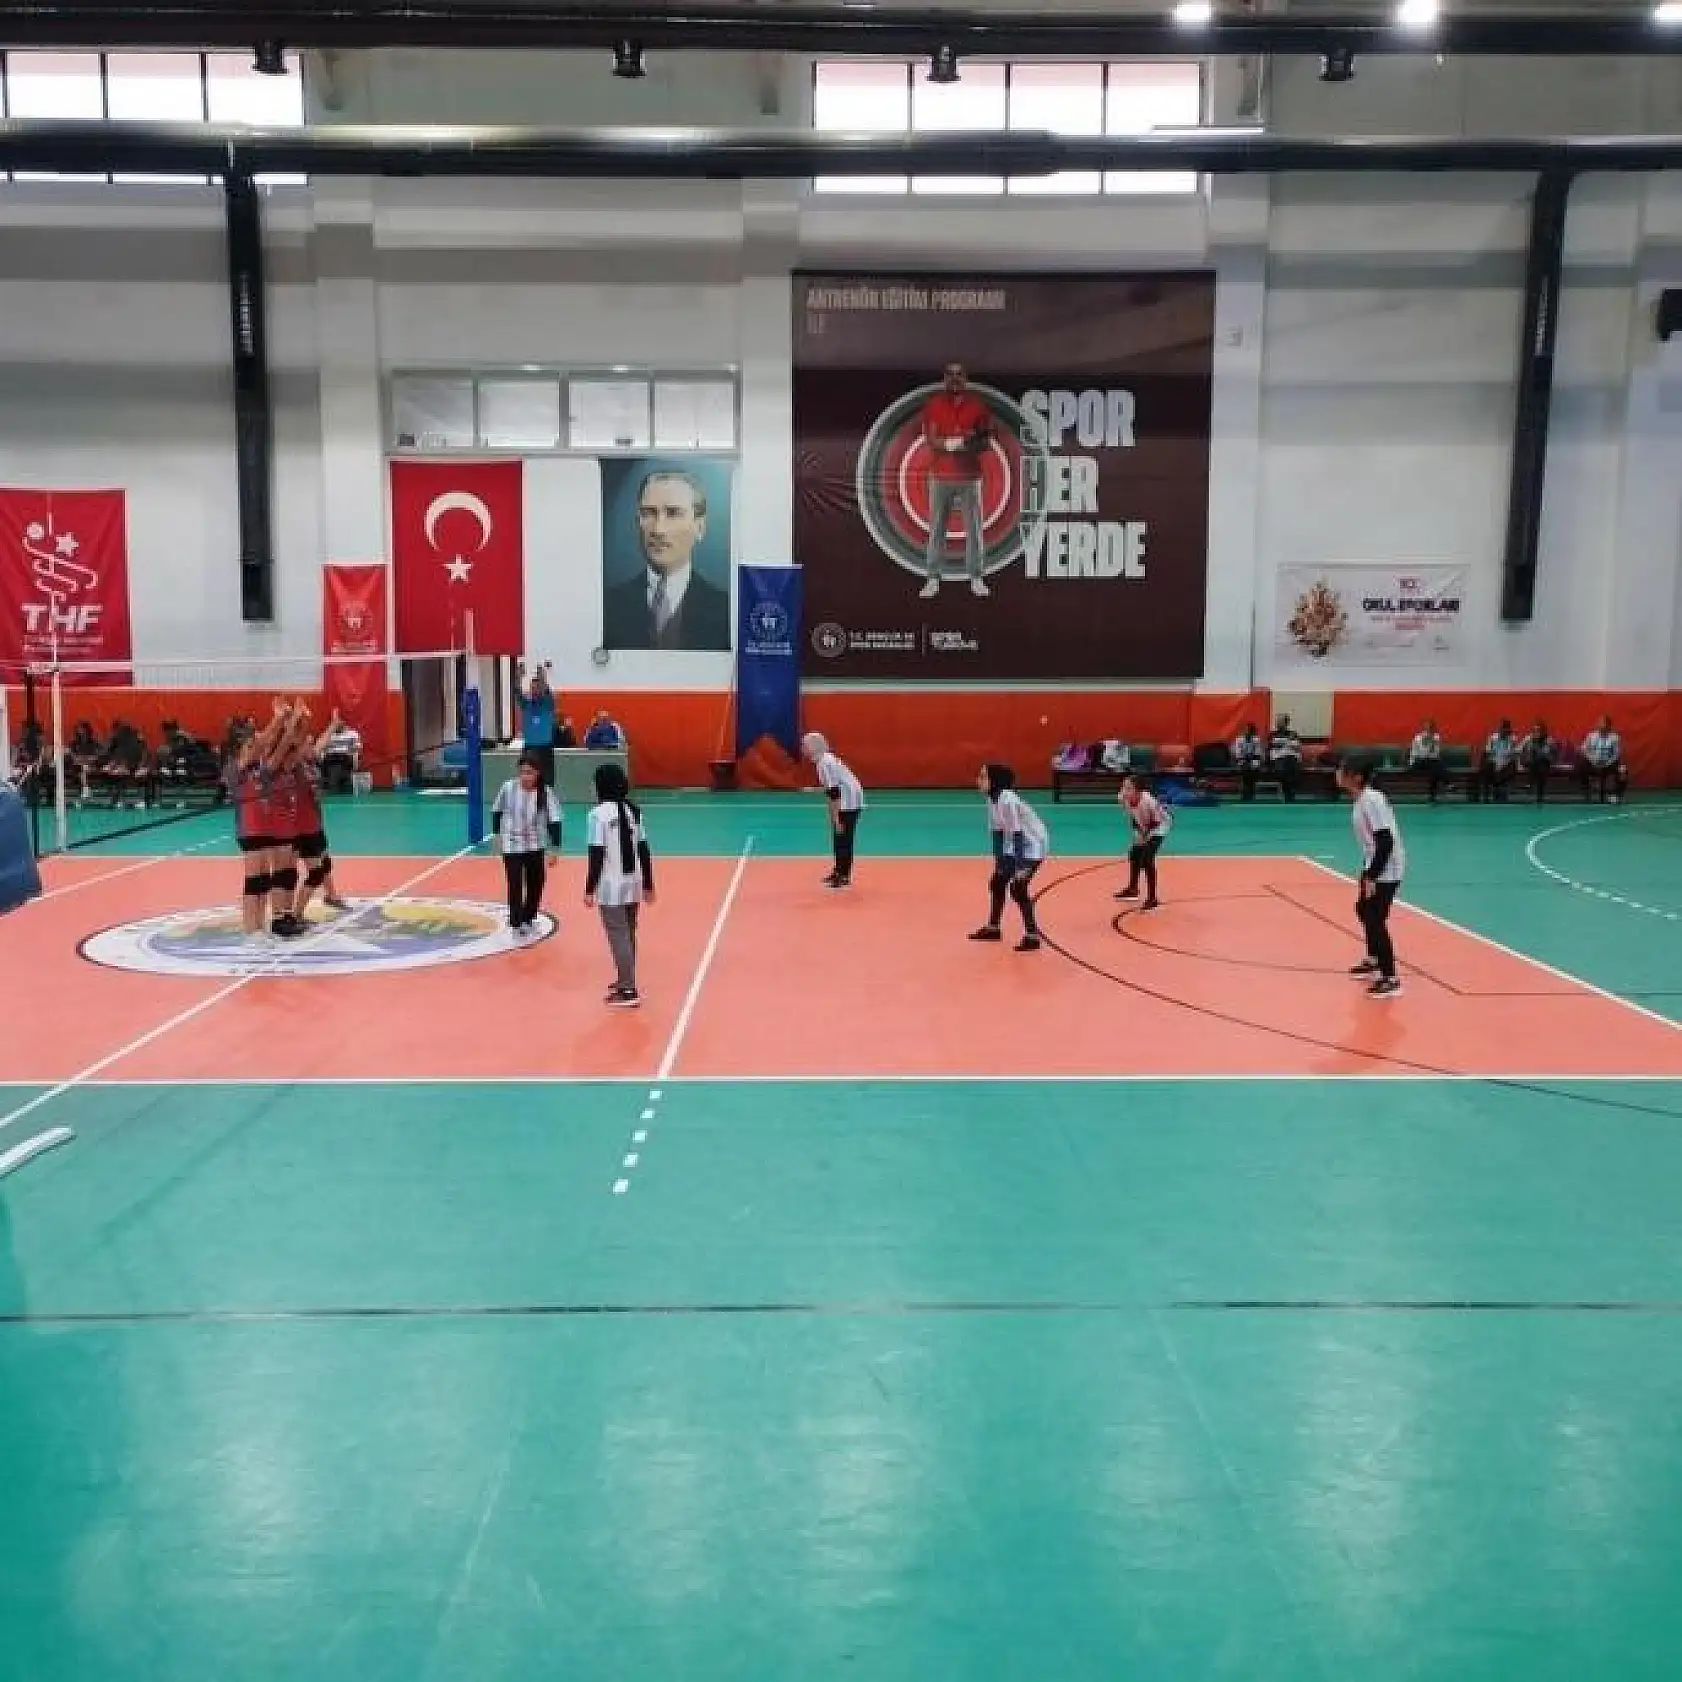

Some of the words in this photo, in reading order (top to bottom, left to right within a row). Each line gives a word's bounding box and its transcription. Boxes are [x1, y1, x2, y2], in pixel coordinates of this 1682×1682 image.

[1020, 389, 1136, 447] SPOR
[1020, 456, 1099, 513] HER
[1020, 522, 1146, 578] YERDE
[20, 603, 103, 633] THF
